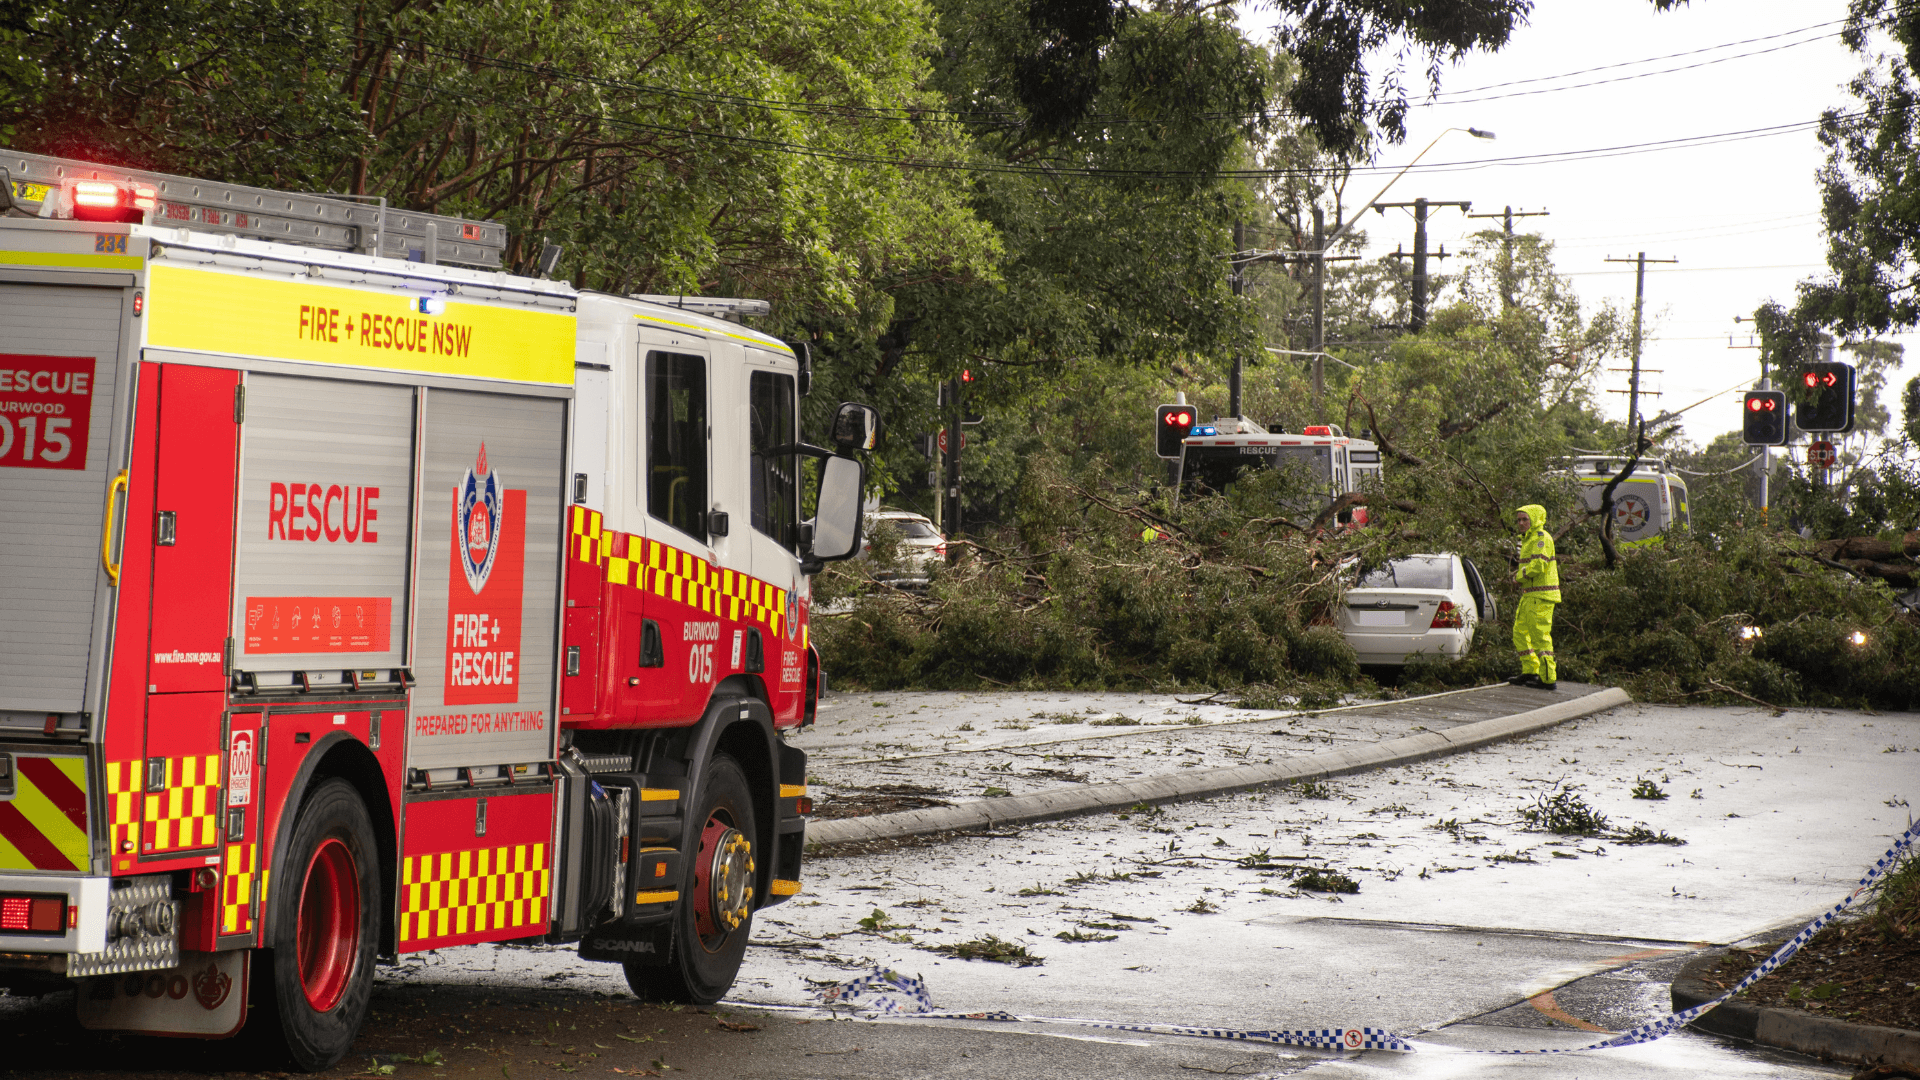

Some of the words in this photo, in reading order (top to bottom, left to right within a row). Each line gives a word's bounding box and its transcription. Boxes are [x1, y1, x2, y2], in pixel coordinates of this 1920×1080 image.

[95, 235, 127, 252] 234
[299, 305, 339, 343] FIRE
[345, 315, 354, 339] +
[360, 313, 428, 353] RESCUE
[432, 322, 472, 358] NSW
[0, 369, 90, 395] ESCUE
[0, 401, 66, 414] URWOOD
[1239, 446, 1277, 455] RESCUE
[1810, 450, 1834, 460] STOP
[268, 482, 380, 543] RESCUE
[683, 621, 719, 641] BURWOOD
[154, 649, 221, 665] www.fire.nsw.gov.au
[689, 644, 713, 683] 015
[451, 651, 514, 686] RESCUE
[782, 667, 801, 682] RESCUE
[415, 715, 468, 737] PREPARED
[470, 713, 491, 734] FOR
[493, 710, 544, 732] ANYTHING
[231, 750, 251, 776] 000
[592, 939, 656, 953] SCANIA
